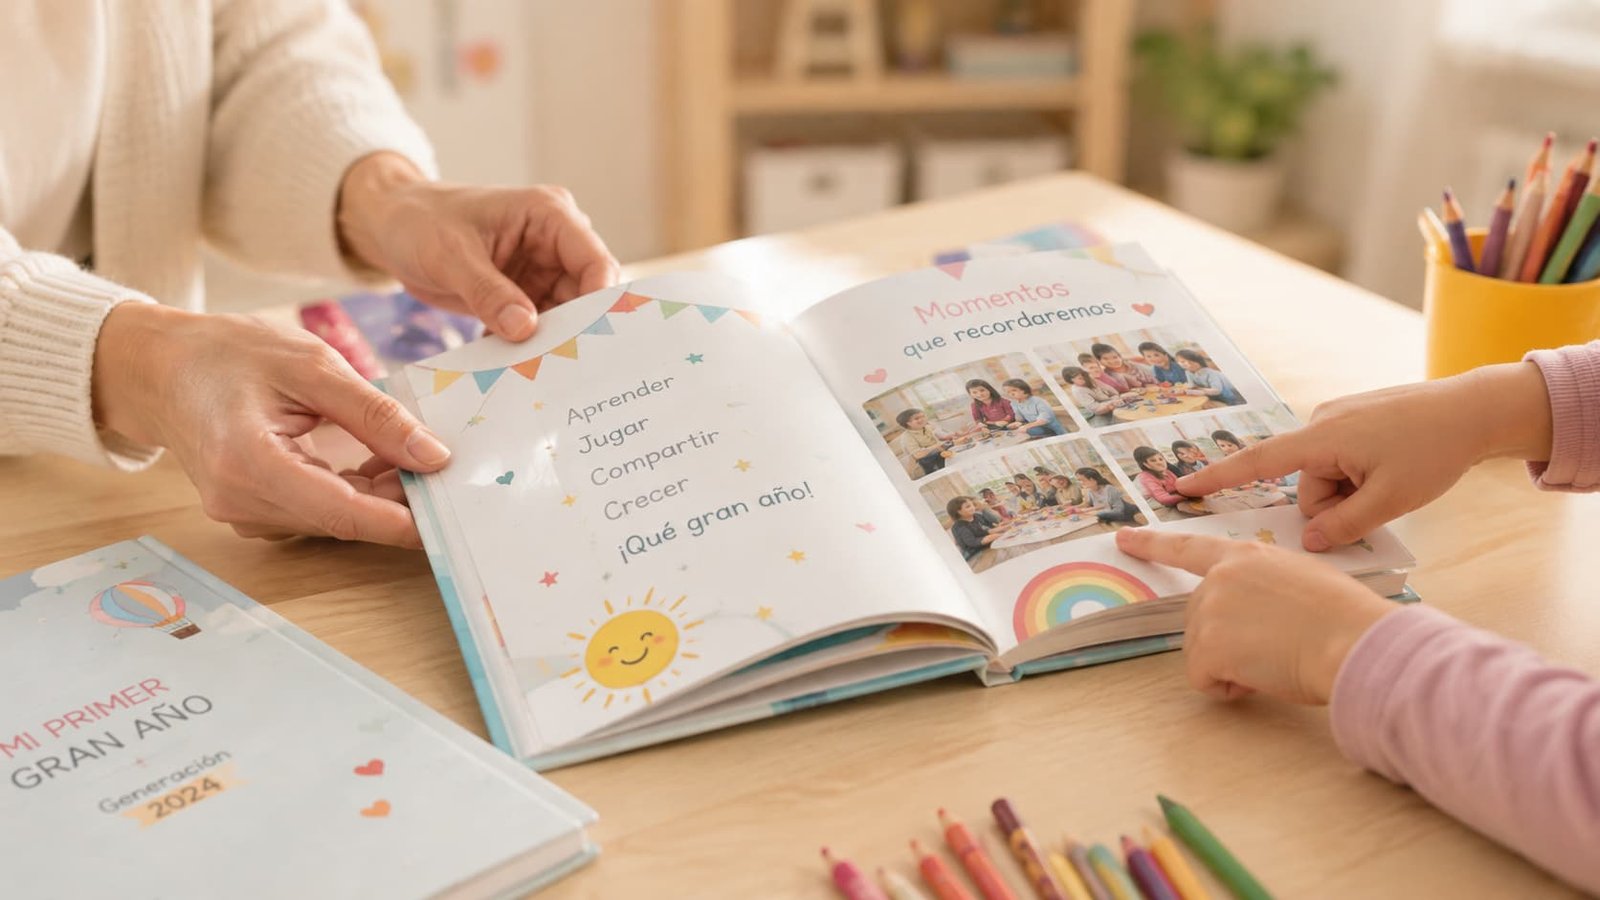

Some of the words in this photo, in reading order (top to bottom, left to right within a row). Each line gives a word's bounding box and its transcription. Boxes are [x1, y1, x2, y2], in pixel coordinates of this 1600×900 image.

[903, 335, 947, 359] que
[953, 301, 1116, 342] recordaremos
[913, 282, 1070, 325] Momentos
[567, 376, 675, 426] Aprender
[578, 416, 649, 454] Jugar
[590, 429, 720, 486] Compartir
[603, 477, 689, 521] Crecer
[618, 521, 677, 564] ¡Qué
[687, 500, 749, 537] gran
[758, 481, 814, 508] año!
[0, 731, 41, 758] MI
[43, 677, 170, 738] PRIMER
[10, 730, 125, 790] GRAN
[134, 695, 213, 739] AÑO
[98, 749, 232, 814] Generación
[147, 776, 222, 819] 2024
